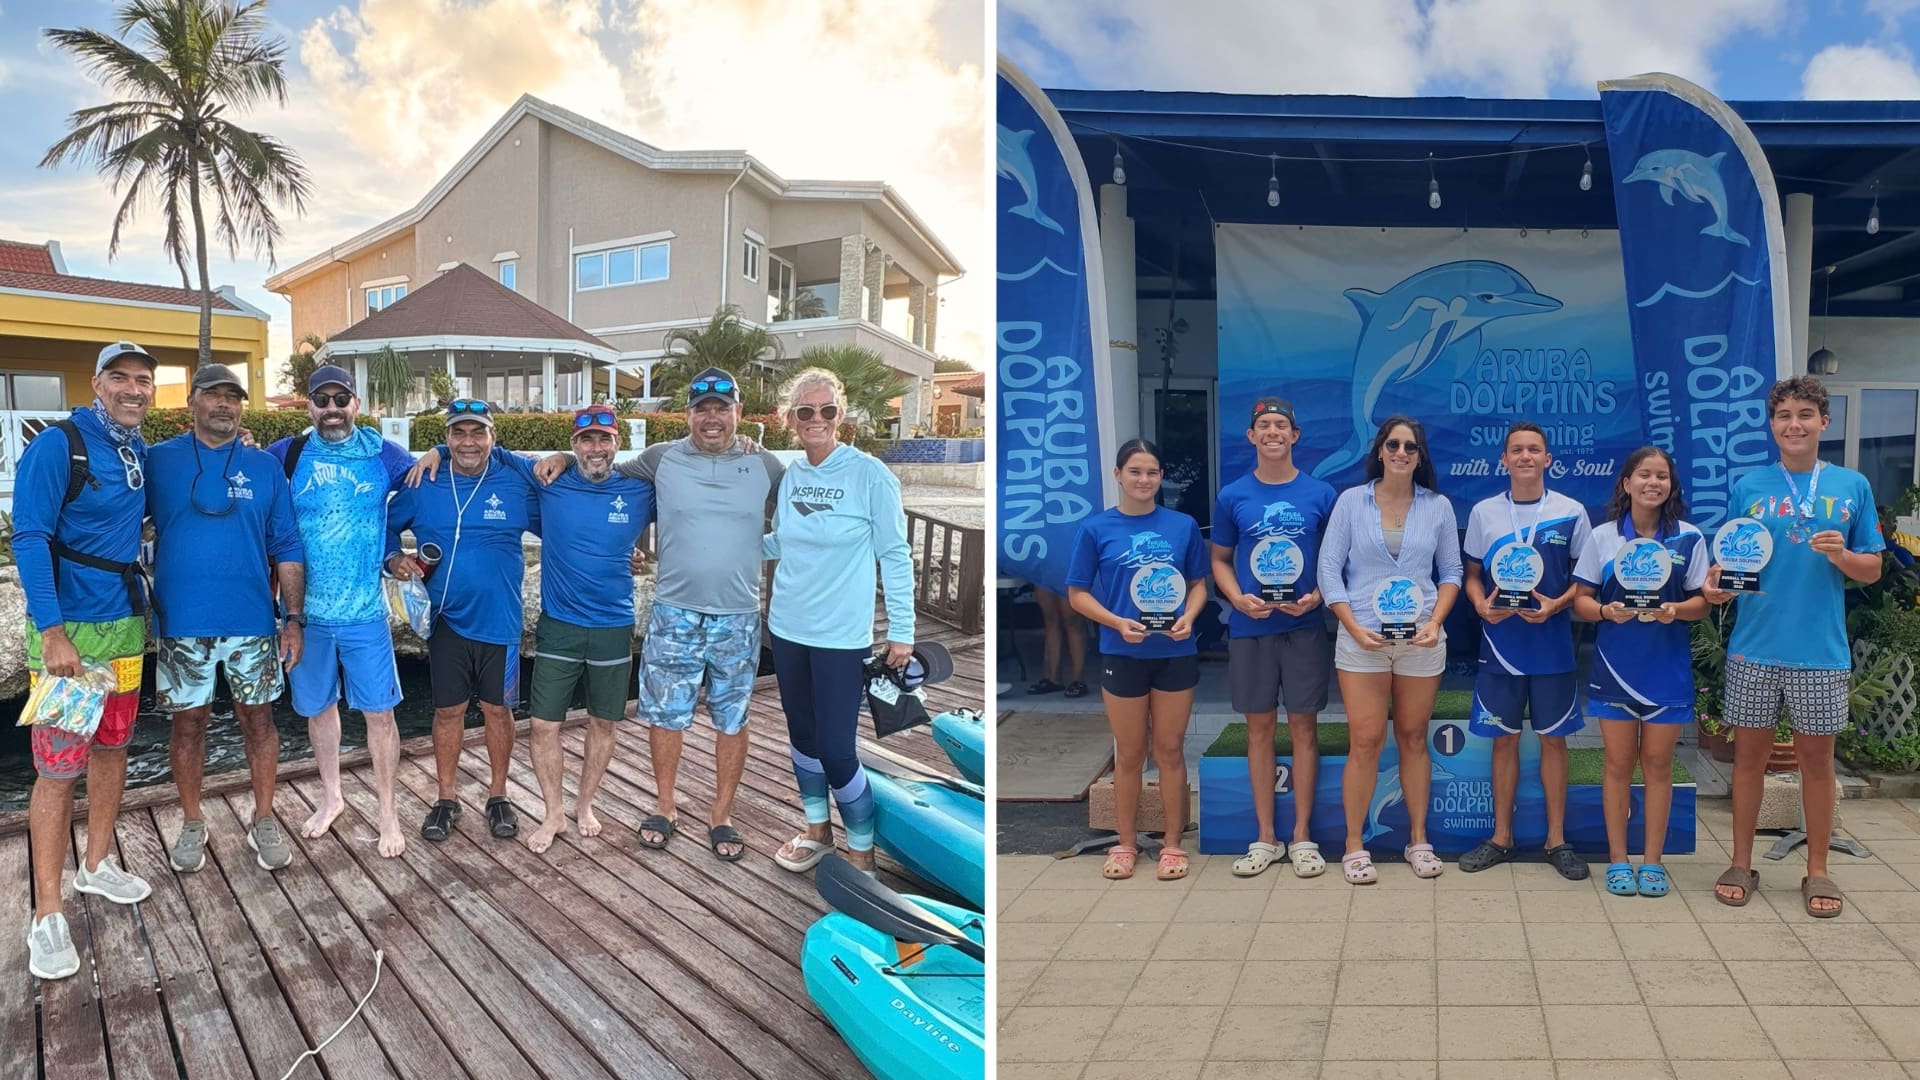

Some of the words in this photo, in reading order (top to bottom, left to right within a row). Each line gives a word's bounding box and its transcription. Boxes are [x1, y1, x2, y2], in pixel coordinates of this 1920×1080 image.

[1475, 348, 1592, 381] ARUBA
[1450, 380, 1617, 414] DOLPHINS
[996, 320, 1048, 562] DOLPHINS
[1043, 355, 1093, 525] ARUBA
[1470, 419, 1596, 446] swiming
[1684, 334, 1730, 538] DOLPHIN
[1450, 459, 1490, 476] with
[1549, 459, 1569, 479] &
[1573, 459, 1615, 476] Soul
[791, 486, 845, 500] INSPIRED
[1441, 727, 1454, 754] 1
[1274, 765, 1289, 793] 2
[1446, 781, 1493, 796] ARUB
[891, 998, 961, 1053] Daylite
